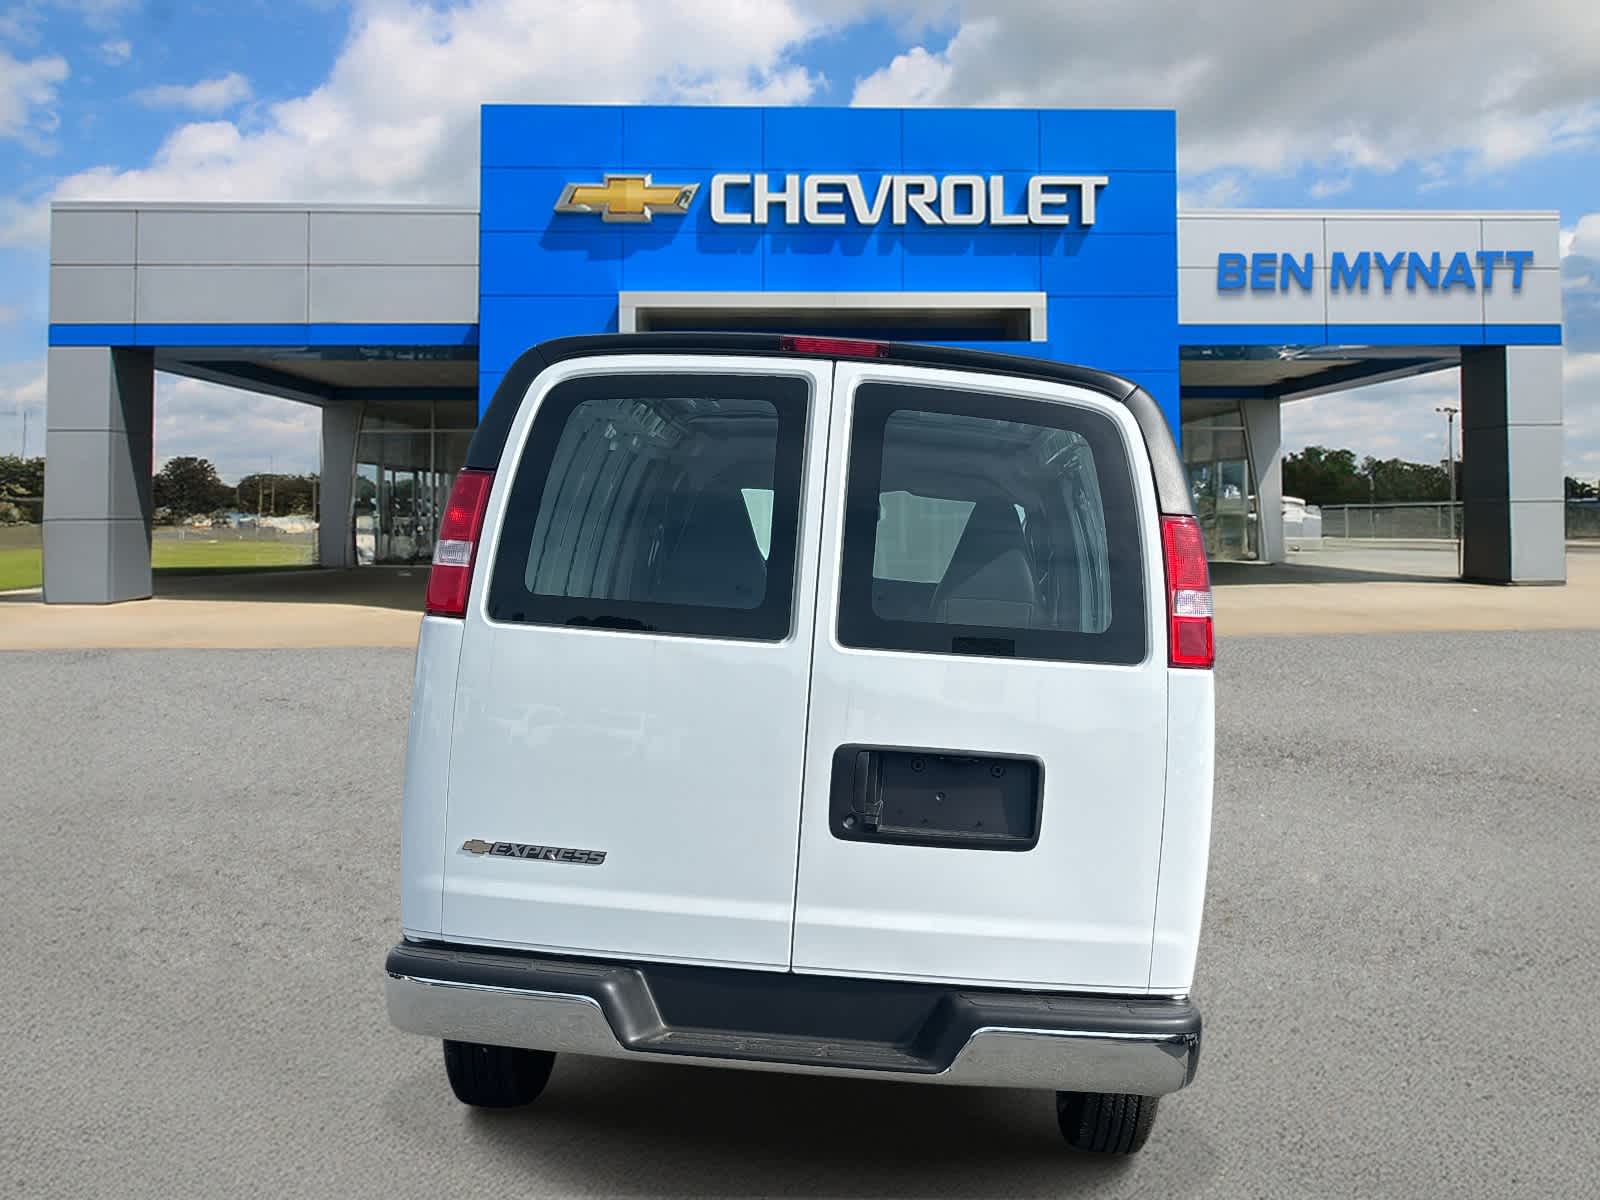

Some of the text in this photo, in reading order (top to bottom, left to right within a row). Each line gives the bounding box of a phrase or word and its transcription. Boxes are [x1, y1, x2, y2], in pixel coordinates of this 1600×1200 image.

[710, 174, 1109, 225] CHEVROLET
[1217, 250, 1534, 290] BEN MYNATT
[490, 842, 607, 864] EXPRESS
